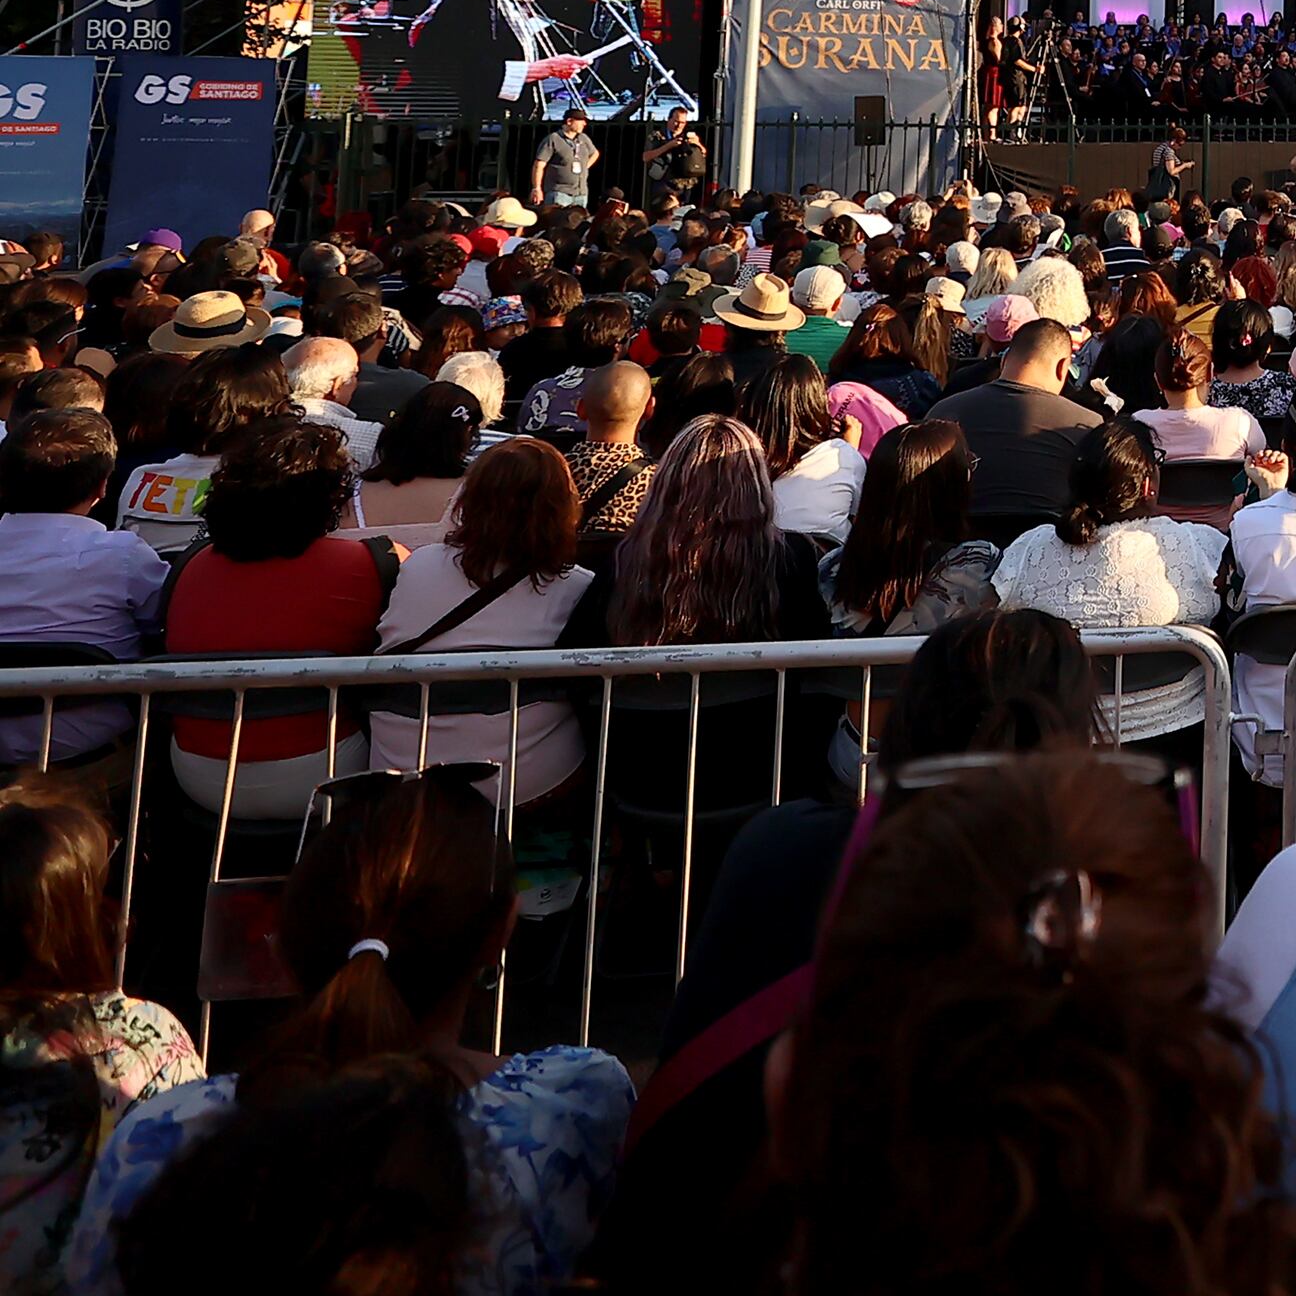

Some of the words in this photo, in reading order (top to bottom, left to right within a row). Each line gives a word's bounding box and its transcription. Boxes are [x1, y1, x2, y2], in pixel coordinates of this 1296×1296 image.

[86, 19, 126, 39] BIO
[133, 19, 171, 39] BIO
[767, 8, 928, 36] CARMINA
[86, 40, 107, 51] LA
[111, 40, 171, 51] RADIO
[134, 74, 192, 104] GS
[199, 90, 259, 99] SANTIAGO
